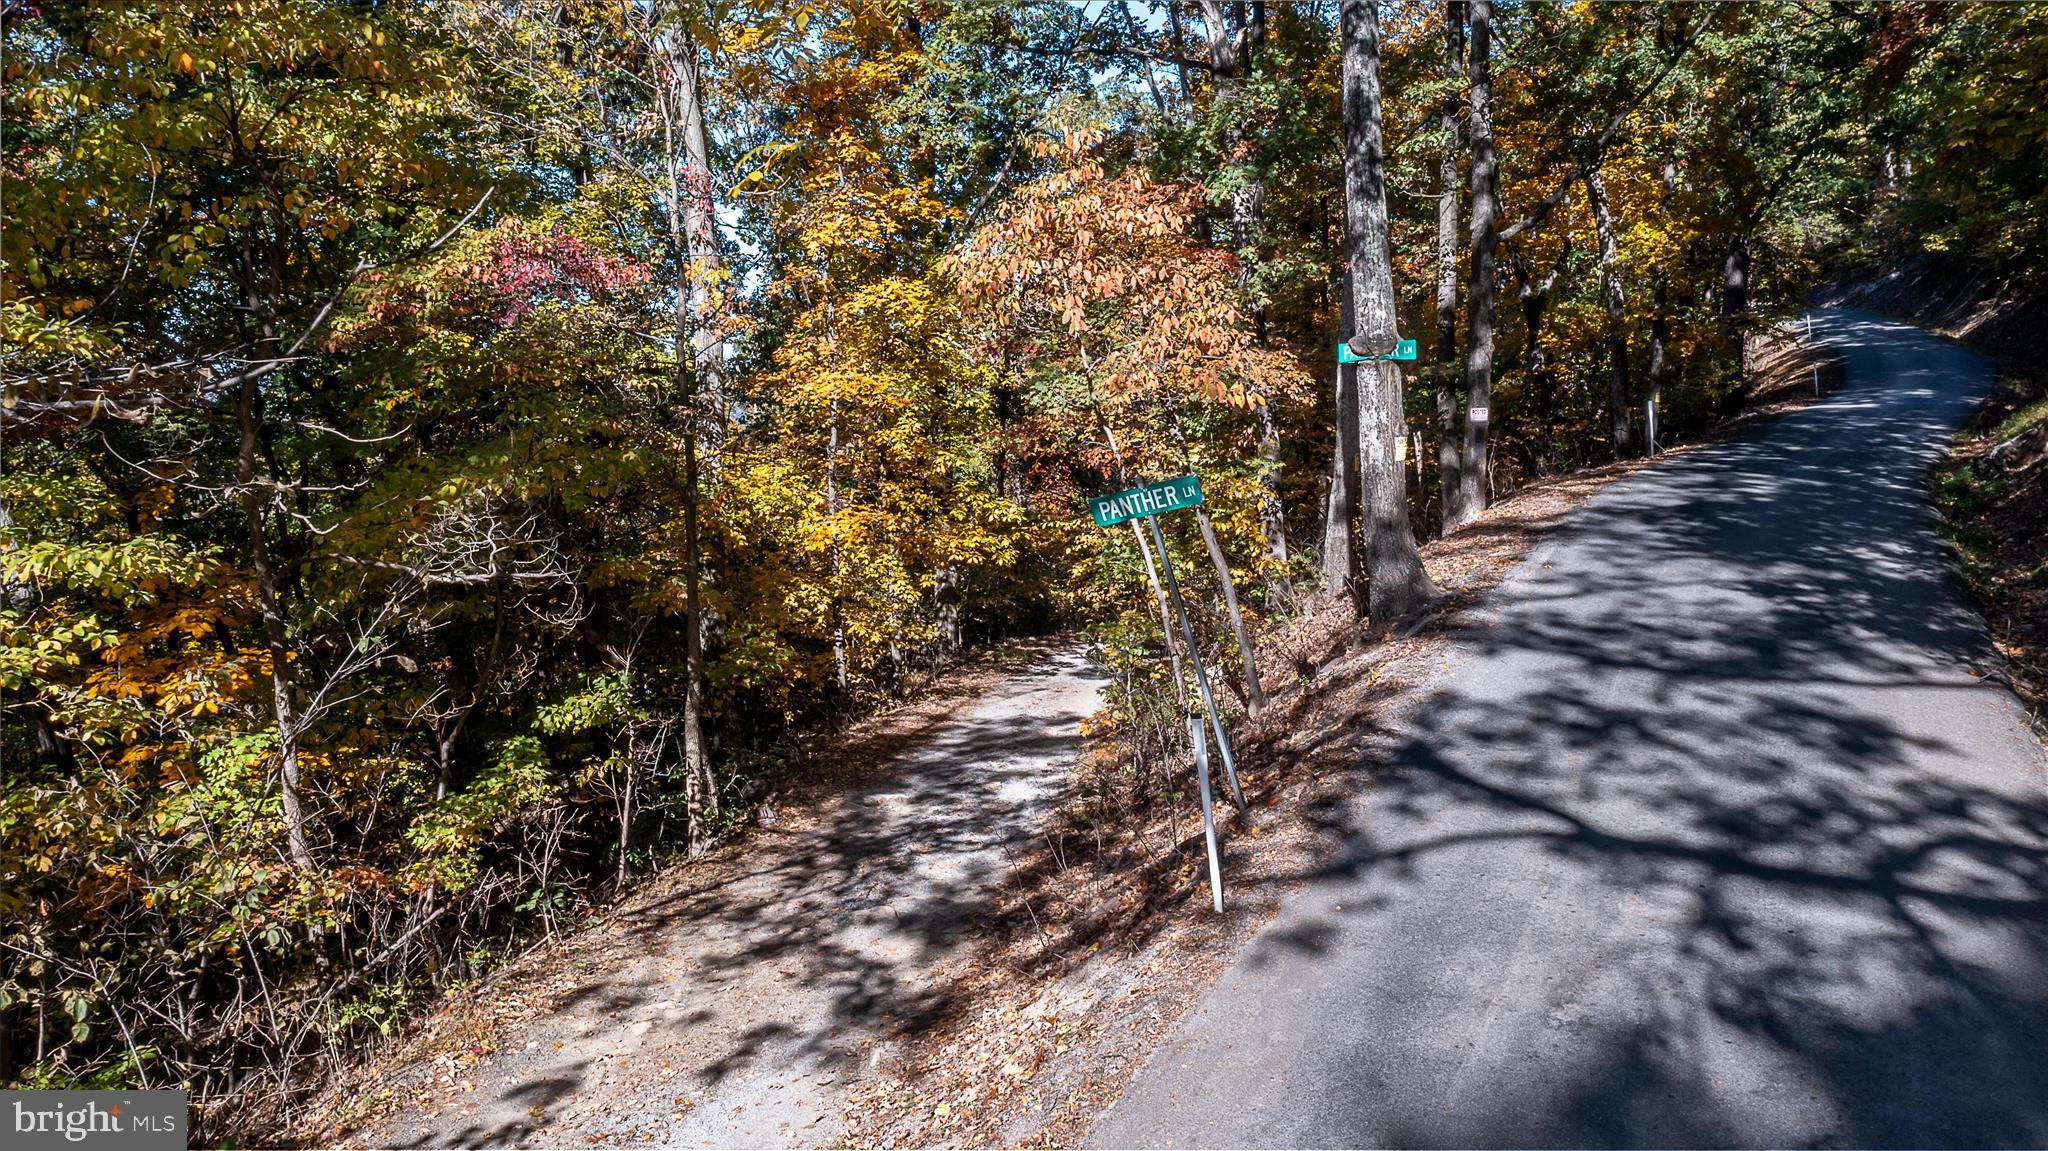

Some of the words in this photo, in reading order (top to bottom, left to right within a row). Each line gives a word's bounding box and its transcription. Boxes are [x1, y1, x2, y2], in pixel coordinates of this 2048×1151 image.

[1403, 345, 1413, 354] LN
[1098, 485, 1180, 521] PANTHER
[1182, 485, 1196, 498] LN
